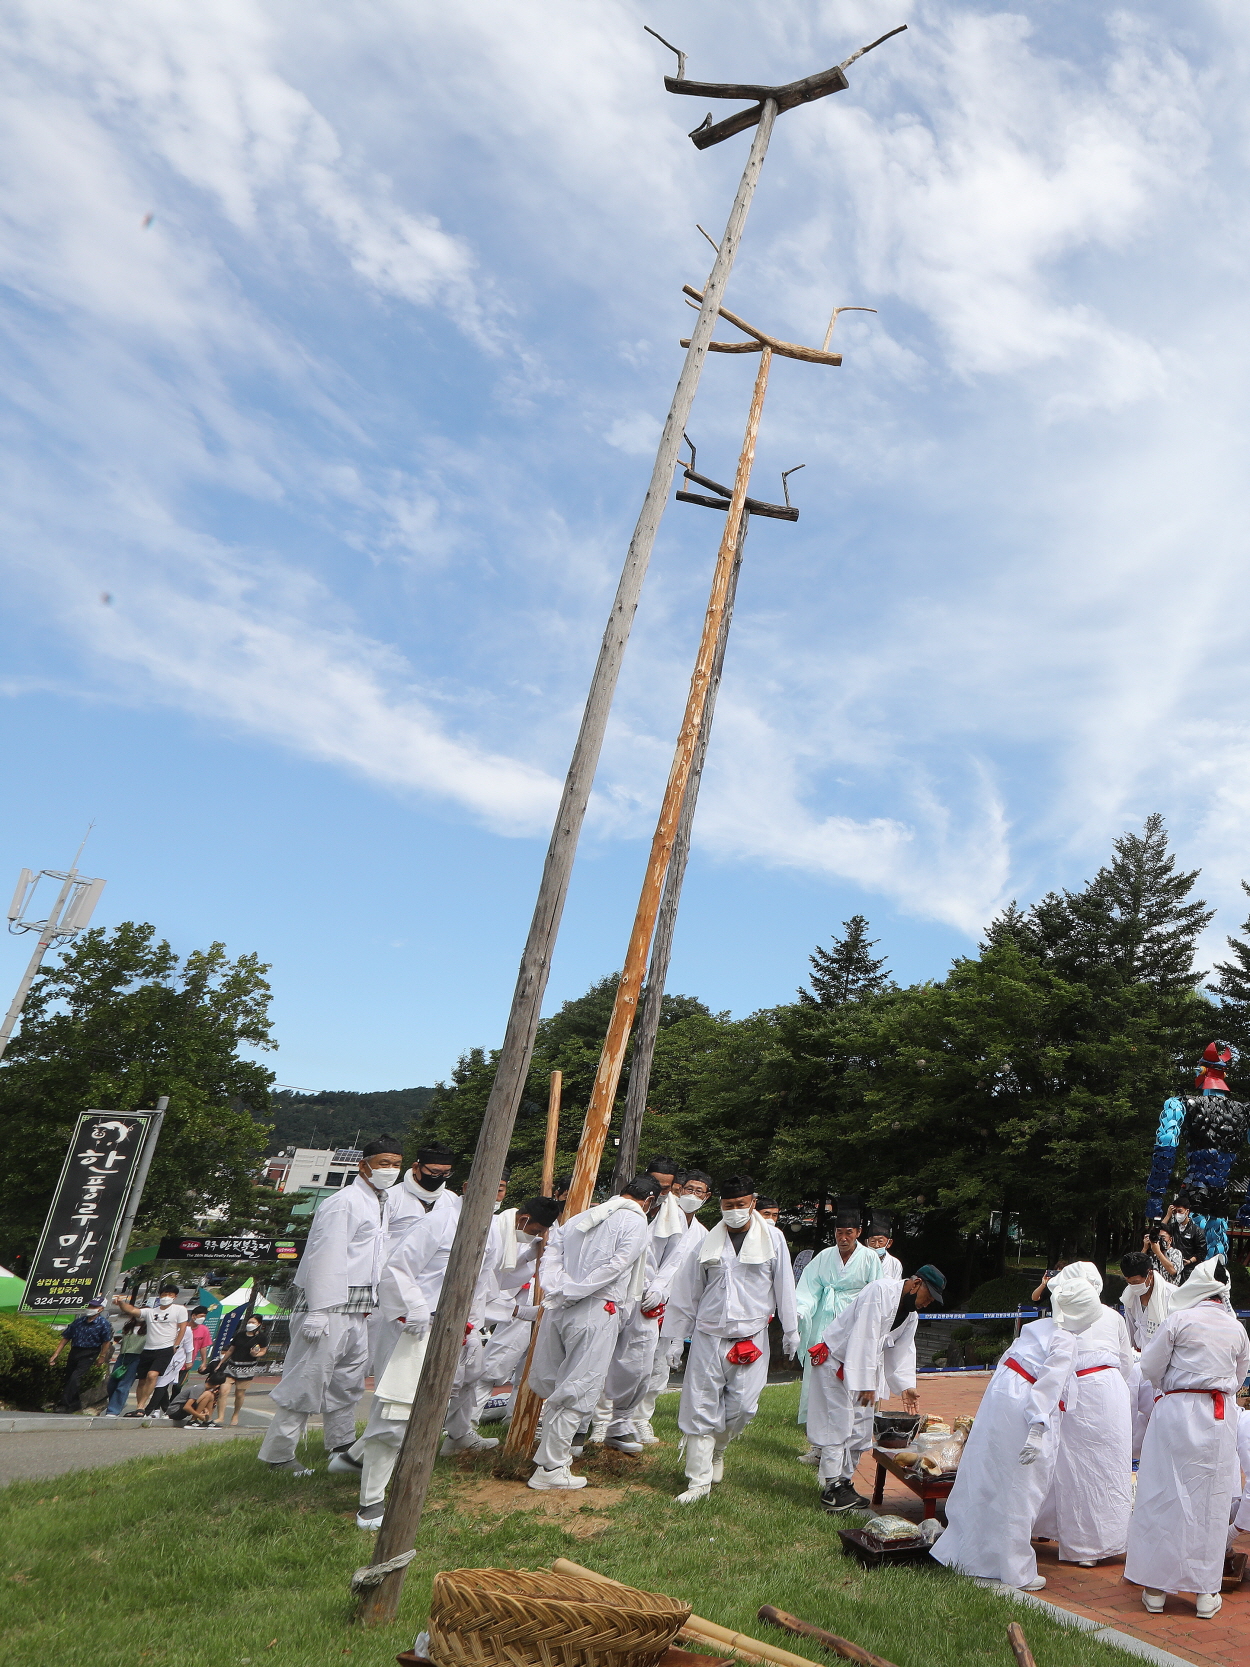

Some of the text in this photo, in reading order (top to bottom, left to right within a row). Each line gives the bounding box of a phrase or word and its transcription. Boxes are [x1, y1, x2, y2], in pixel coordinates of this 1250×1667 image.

[204, 1240, 219, 1251] 무주
[219, 1240, 272, 1259] 반딧불축제
[36, 1277, 93, 1287] 삼겹살 무한리필
[49, 1286, 80, 1295] 닭칼국수
[34, 1296, 84, 1305] 324-7878
